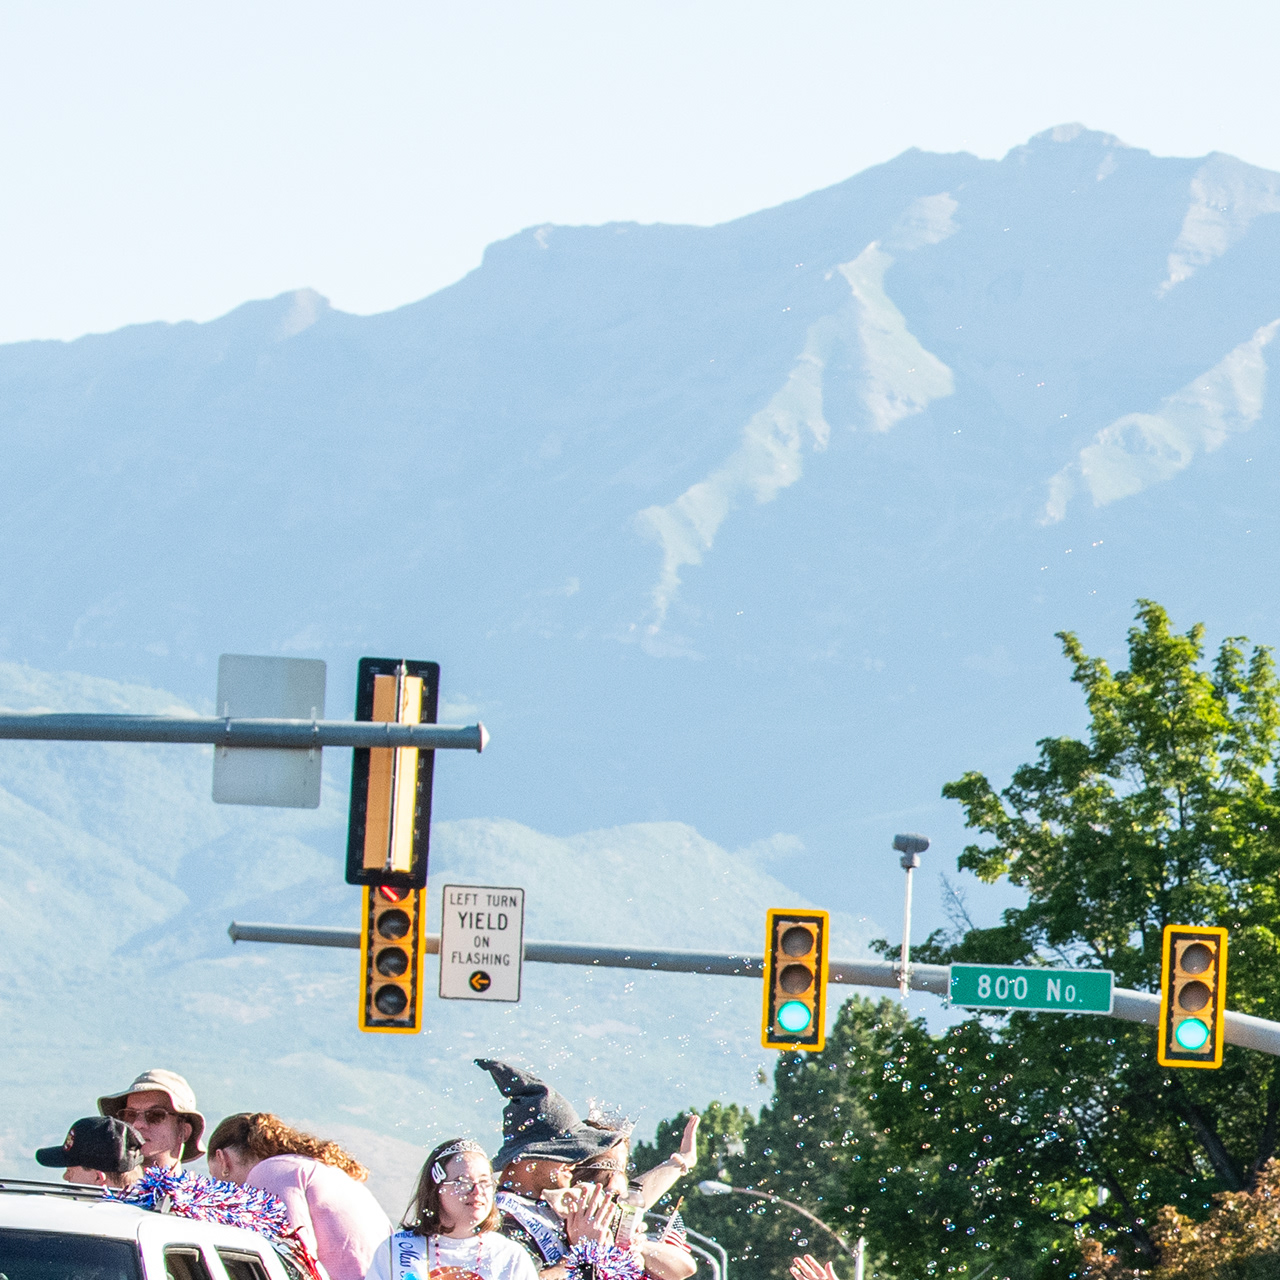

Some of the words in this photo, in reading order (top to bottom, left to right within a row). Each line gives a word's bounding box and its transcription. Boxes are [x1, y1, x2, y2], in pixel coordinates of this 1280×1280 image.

[449, 893, 478, 906] LEFT
[487, 894, 517, 908] TURN
[458, 911, 508, 931] YIELD
[473, 935, 490, 948] ON
[451, 951, 510, 966] FLASHING
[977, 974, 1028, 1000] 800
